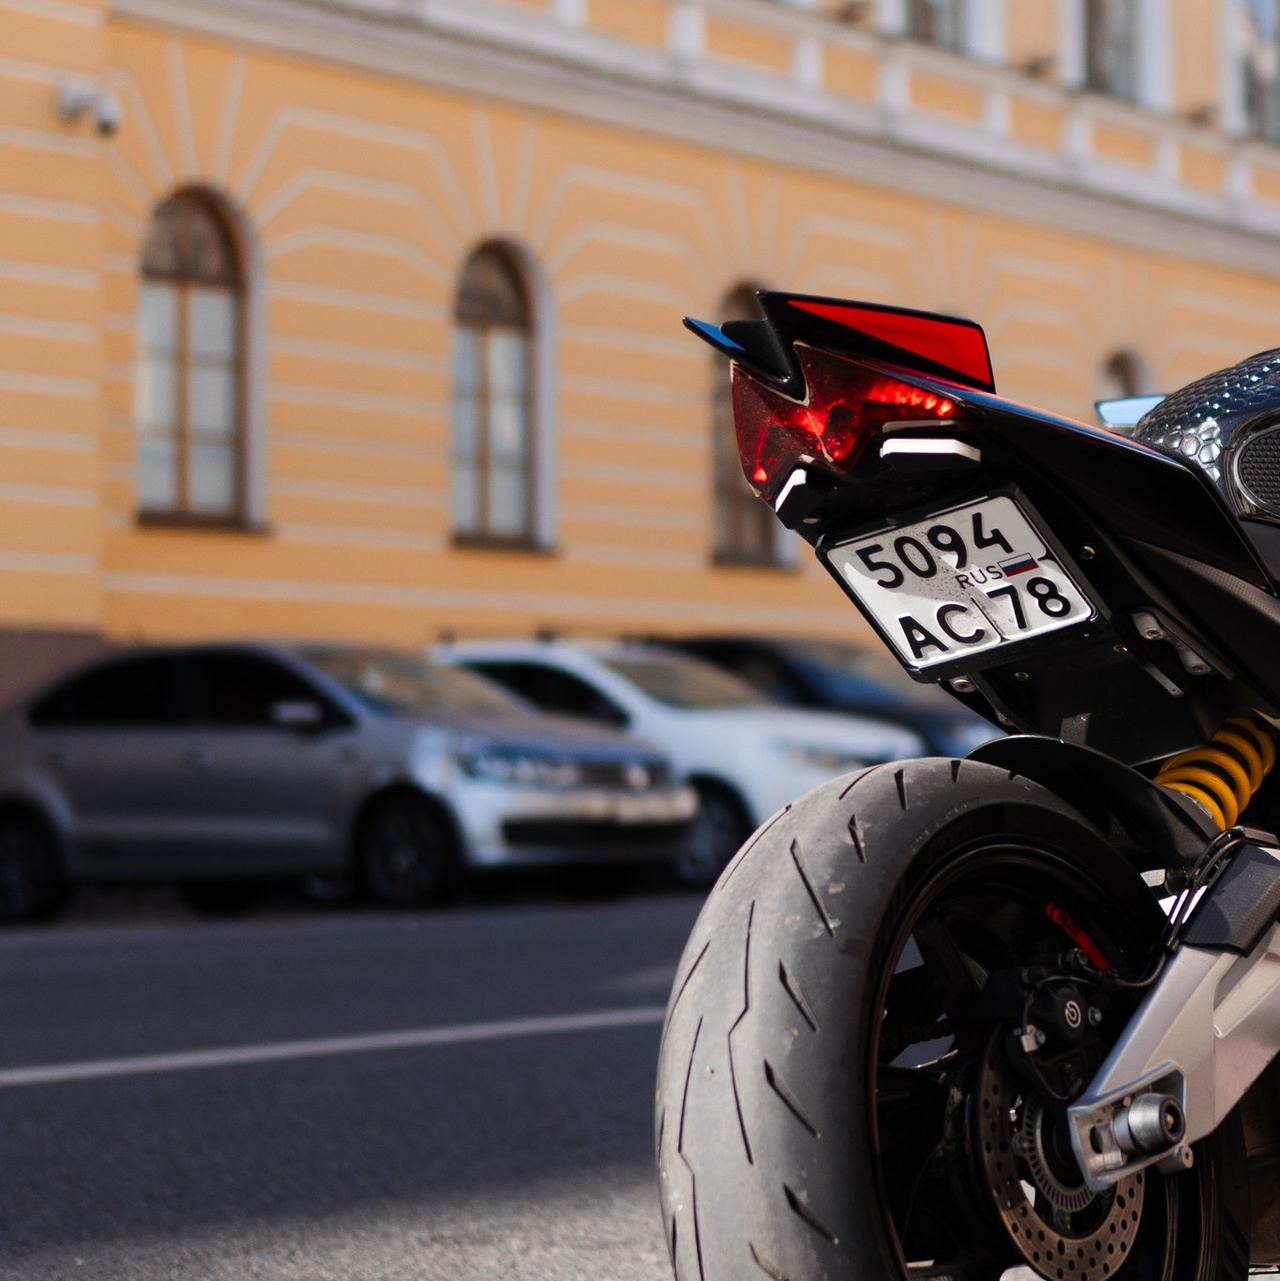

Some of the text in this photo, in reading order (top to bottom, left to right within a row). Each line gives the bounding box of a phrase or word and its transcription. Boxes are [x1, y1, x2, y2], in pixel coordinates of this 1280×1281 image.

[856, 512, 1014, 589] 5094
[955, 565, 1004, 590] RUS
[898, 577, 1071, 659] AC 78
